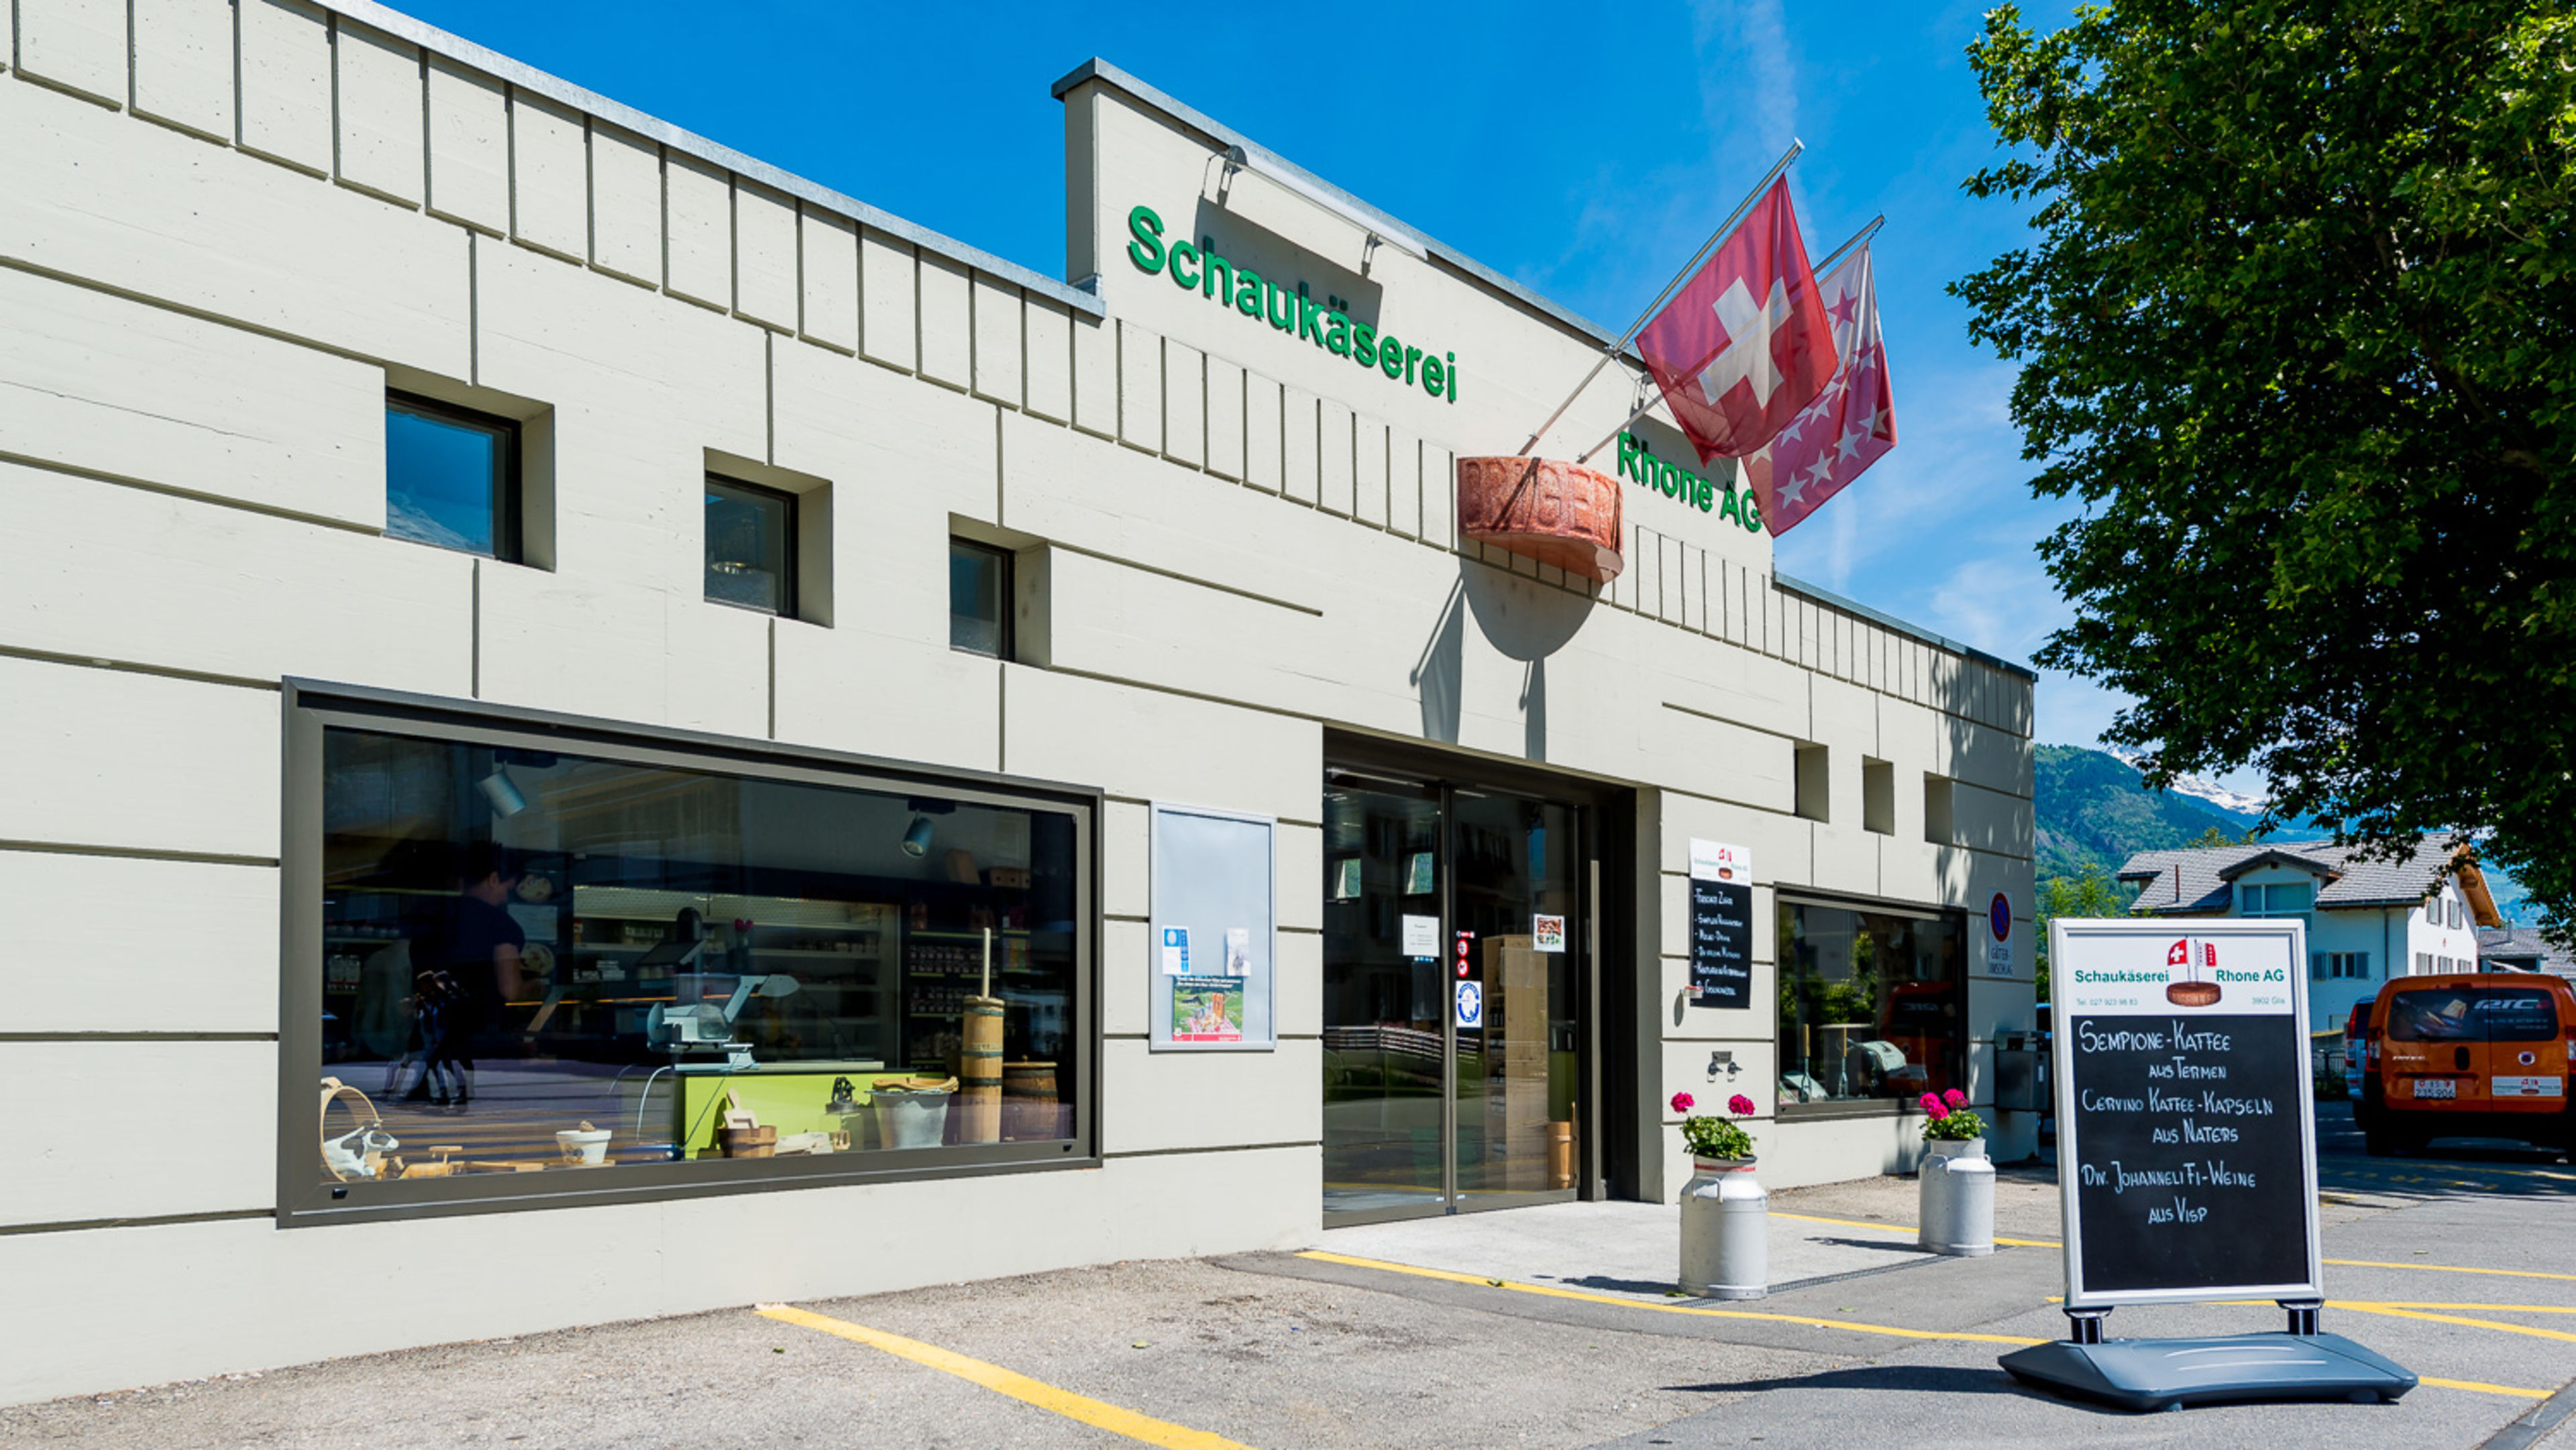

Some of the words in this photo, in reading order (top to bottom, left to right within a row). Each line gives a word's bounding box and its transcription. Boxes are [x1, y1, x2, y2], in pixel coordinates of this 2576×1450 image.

[1128, 205, 1456, 403] Schaukäserei
[1617, 430, 1713, 512] Rhone
[1719, 480, 1762, 532] AG
[2075, 968, 2170, 983] Schaukäserei
[2216, 970, 2260, 982] Rhone
[2263, 969, 2285, 982] AG
[2090, 998, 2102, 1006] 027
